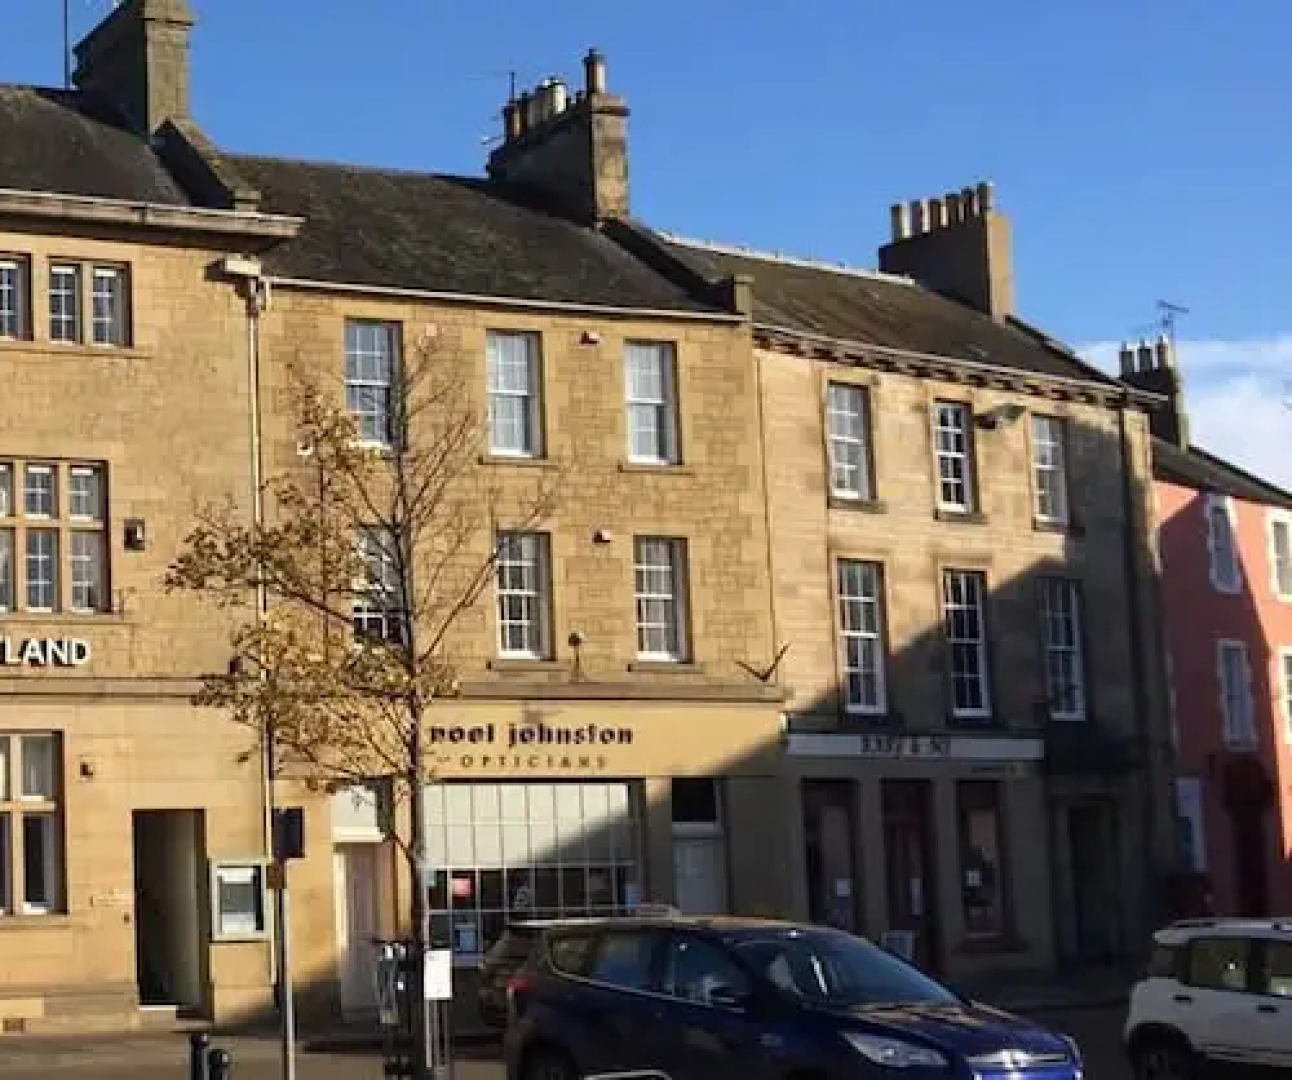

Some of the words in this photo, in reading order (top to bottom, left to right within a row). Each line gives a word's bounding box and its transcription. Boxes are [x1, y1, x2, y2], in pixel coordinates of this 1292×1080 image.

[430, 723, 495, 744] noel
[508, 723, 633, 749] johnston
[461, 754, 607, 768] OPTICIANS
